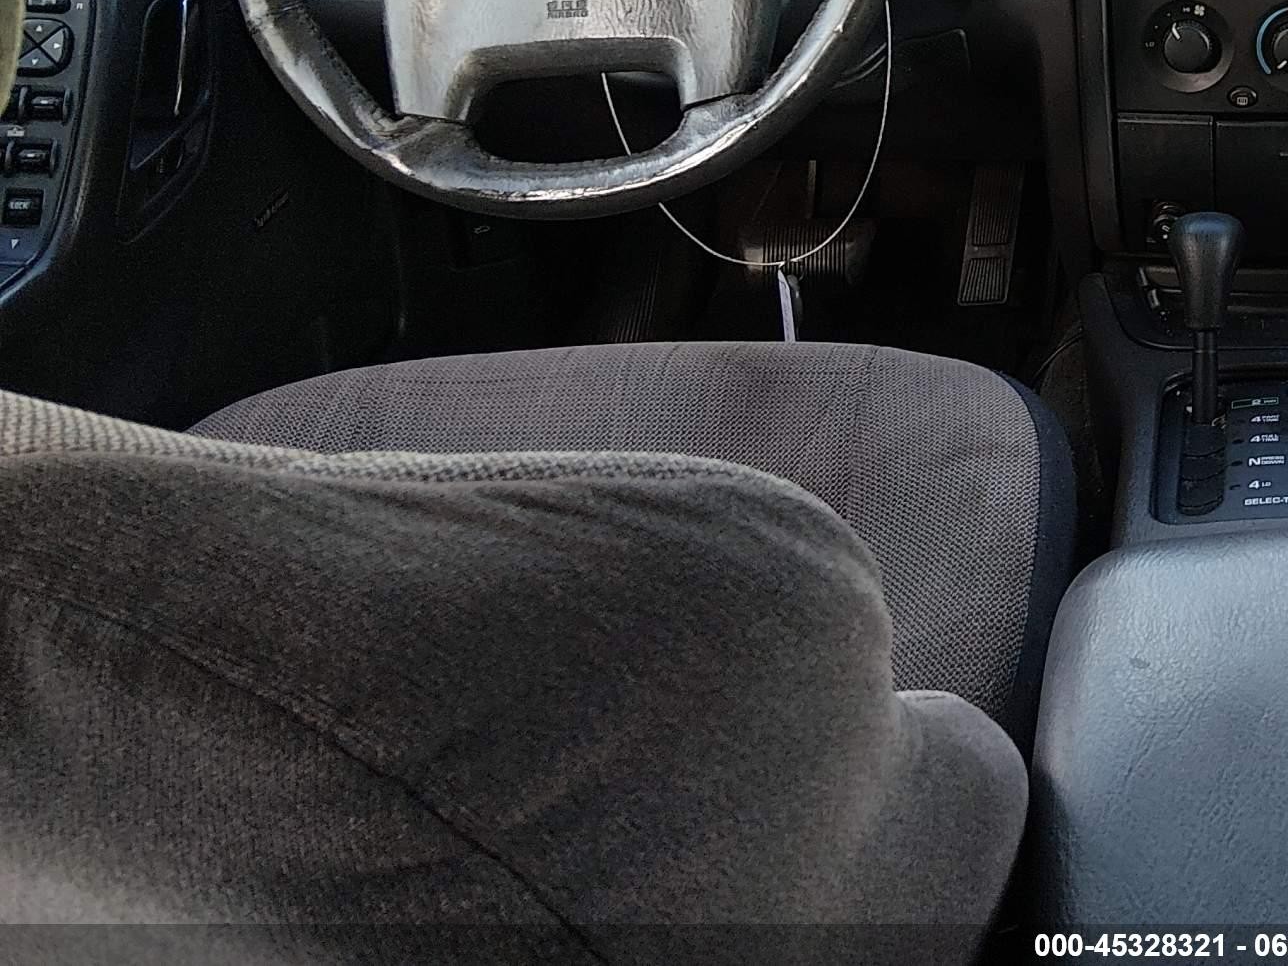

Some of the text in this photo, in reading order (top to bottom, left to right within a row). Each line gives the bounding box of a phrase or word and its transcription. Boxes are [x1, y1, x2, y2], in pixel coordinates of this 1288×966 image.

[1250, 435, 1261, 443] 4
[1248, 456, 1260, 466] N
[1248, 480, 1260, 489] 4
